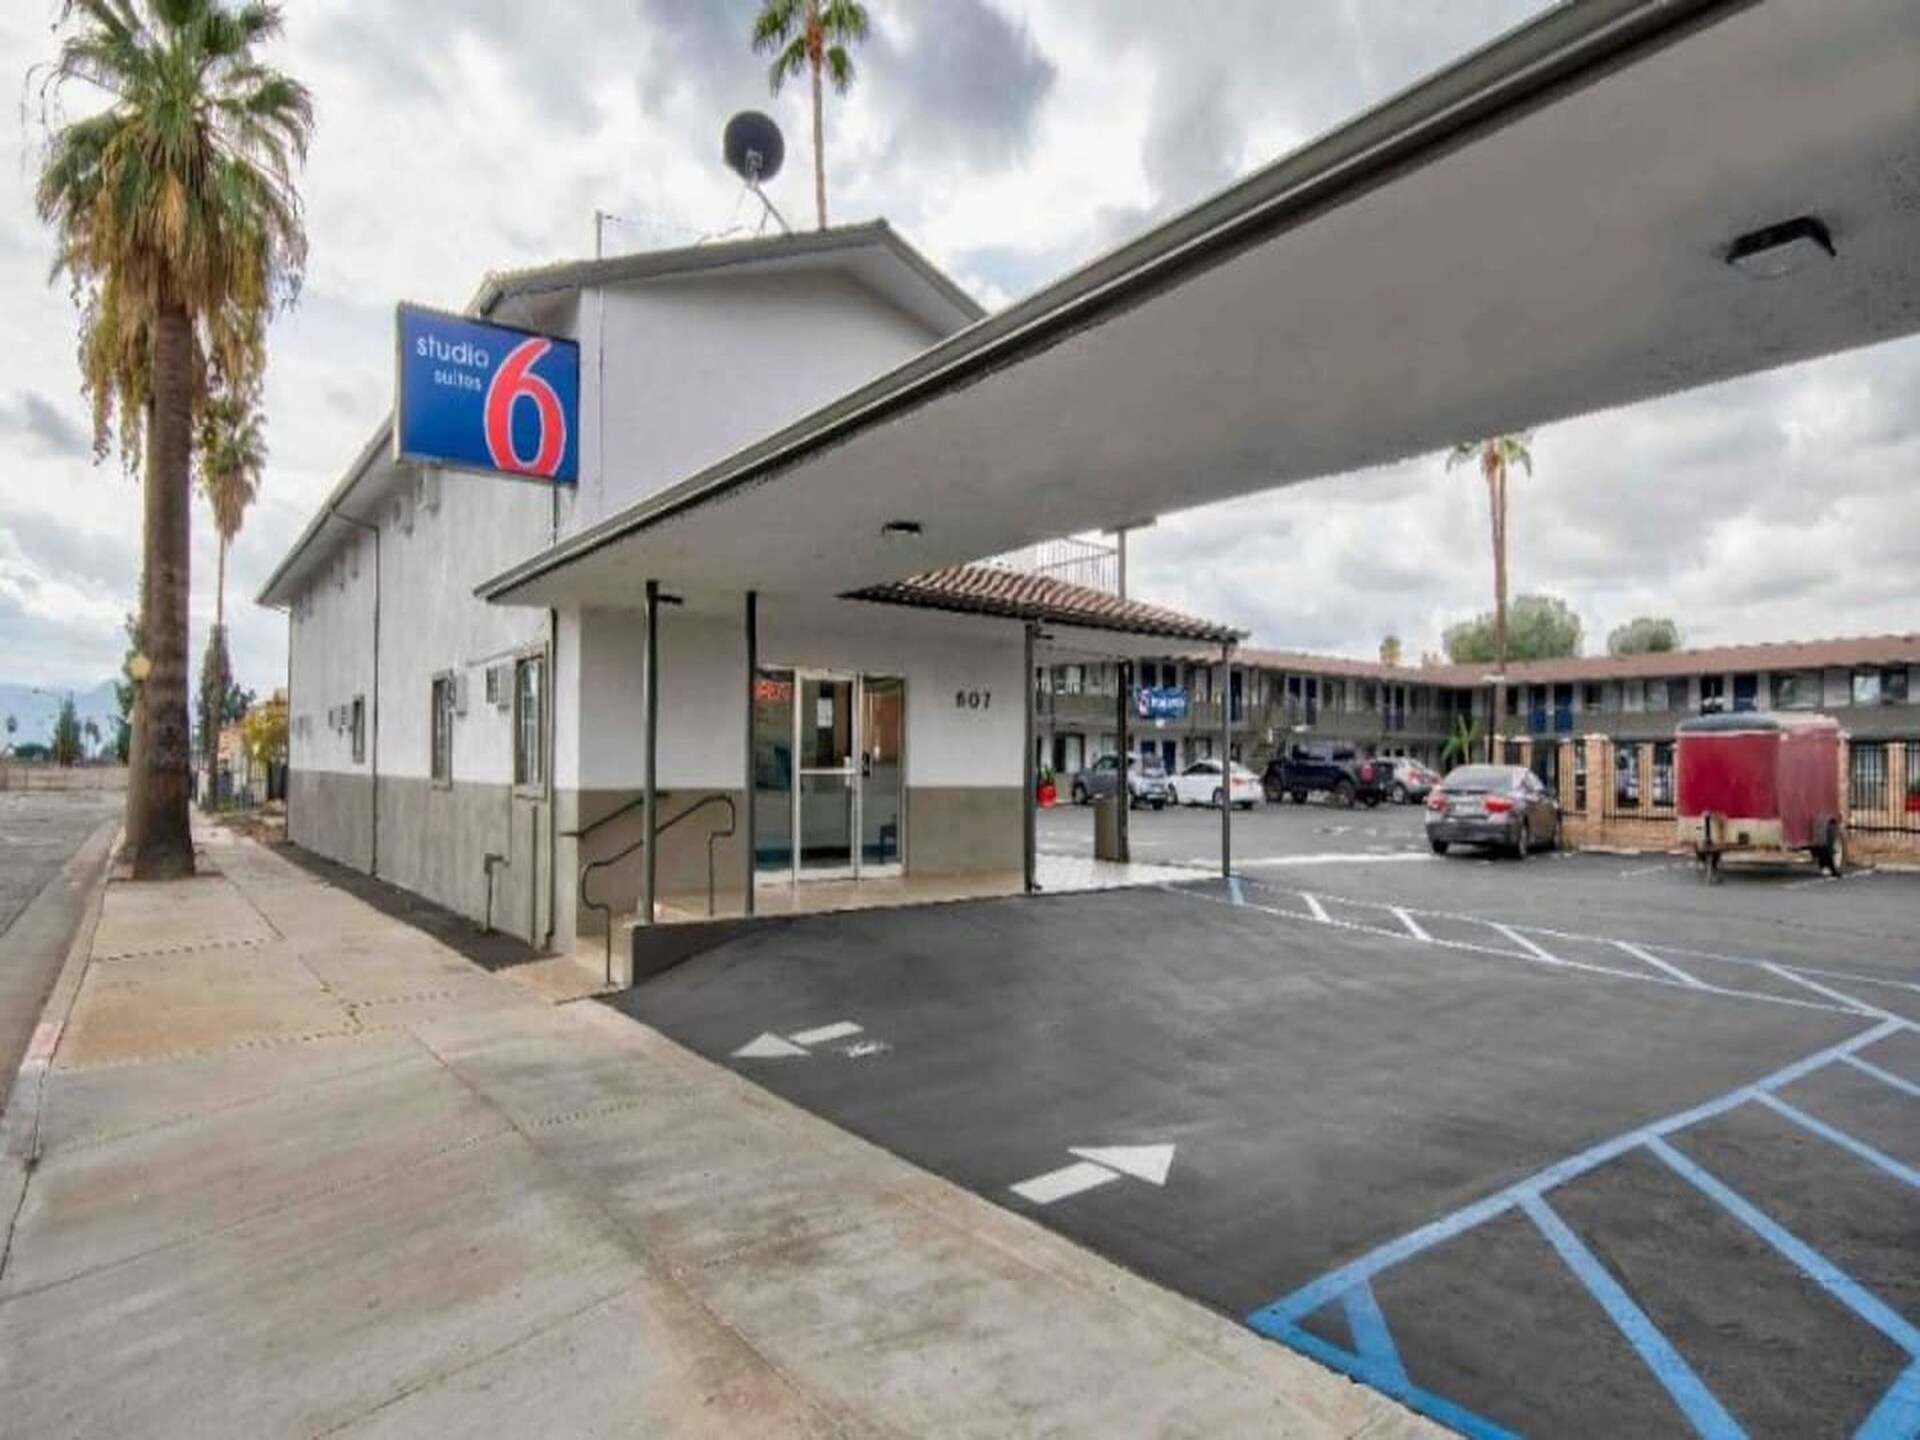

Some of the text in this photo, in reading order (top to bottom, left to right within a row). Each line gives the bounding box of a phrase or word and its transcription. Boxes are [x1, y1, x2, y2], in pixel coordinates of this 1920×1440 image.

[416, 334, 489, 368] studio
[434, 369, 482, 391] suites
[484, 337, 567, 477] 6
[956, 690, 991, 709] 607
